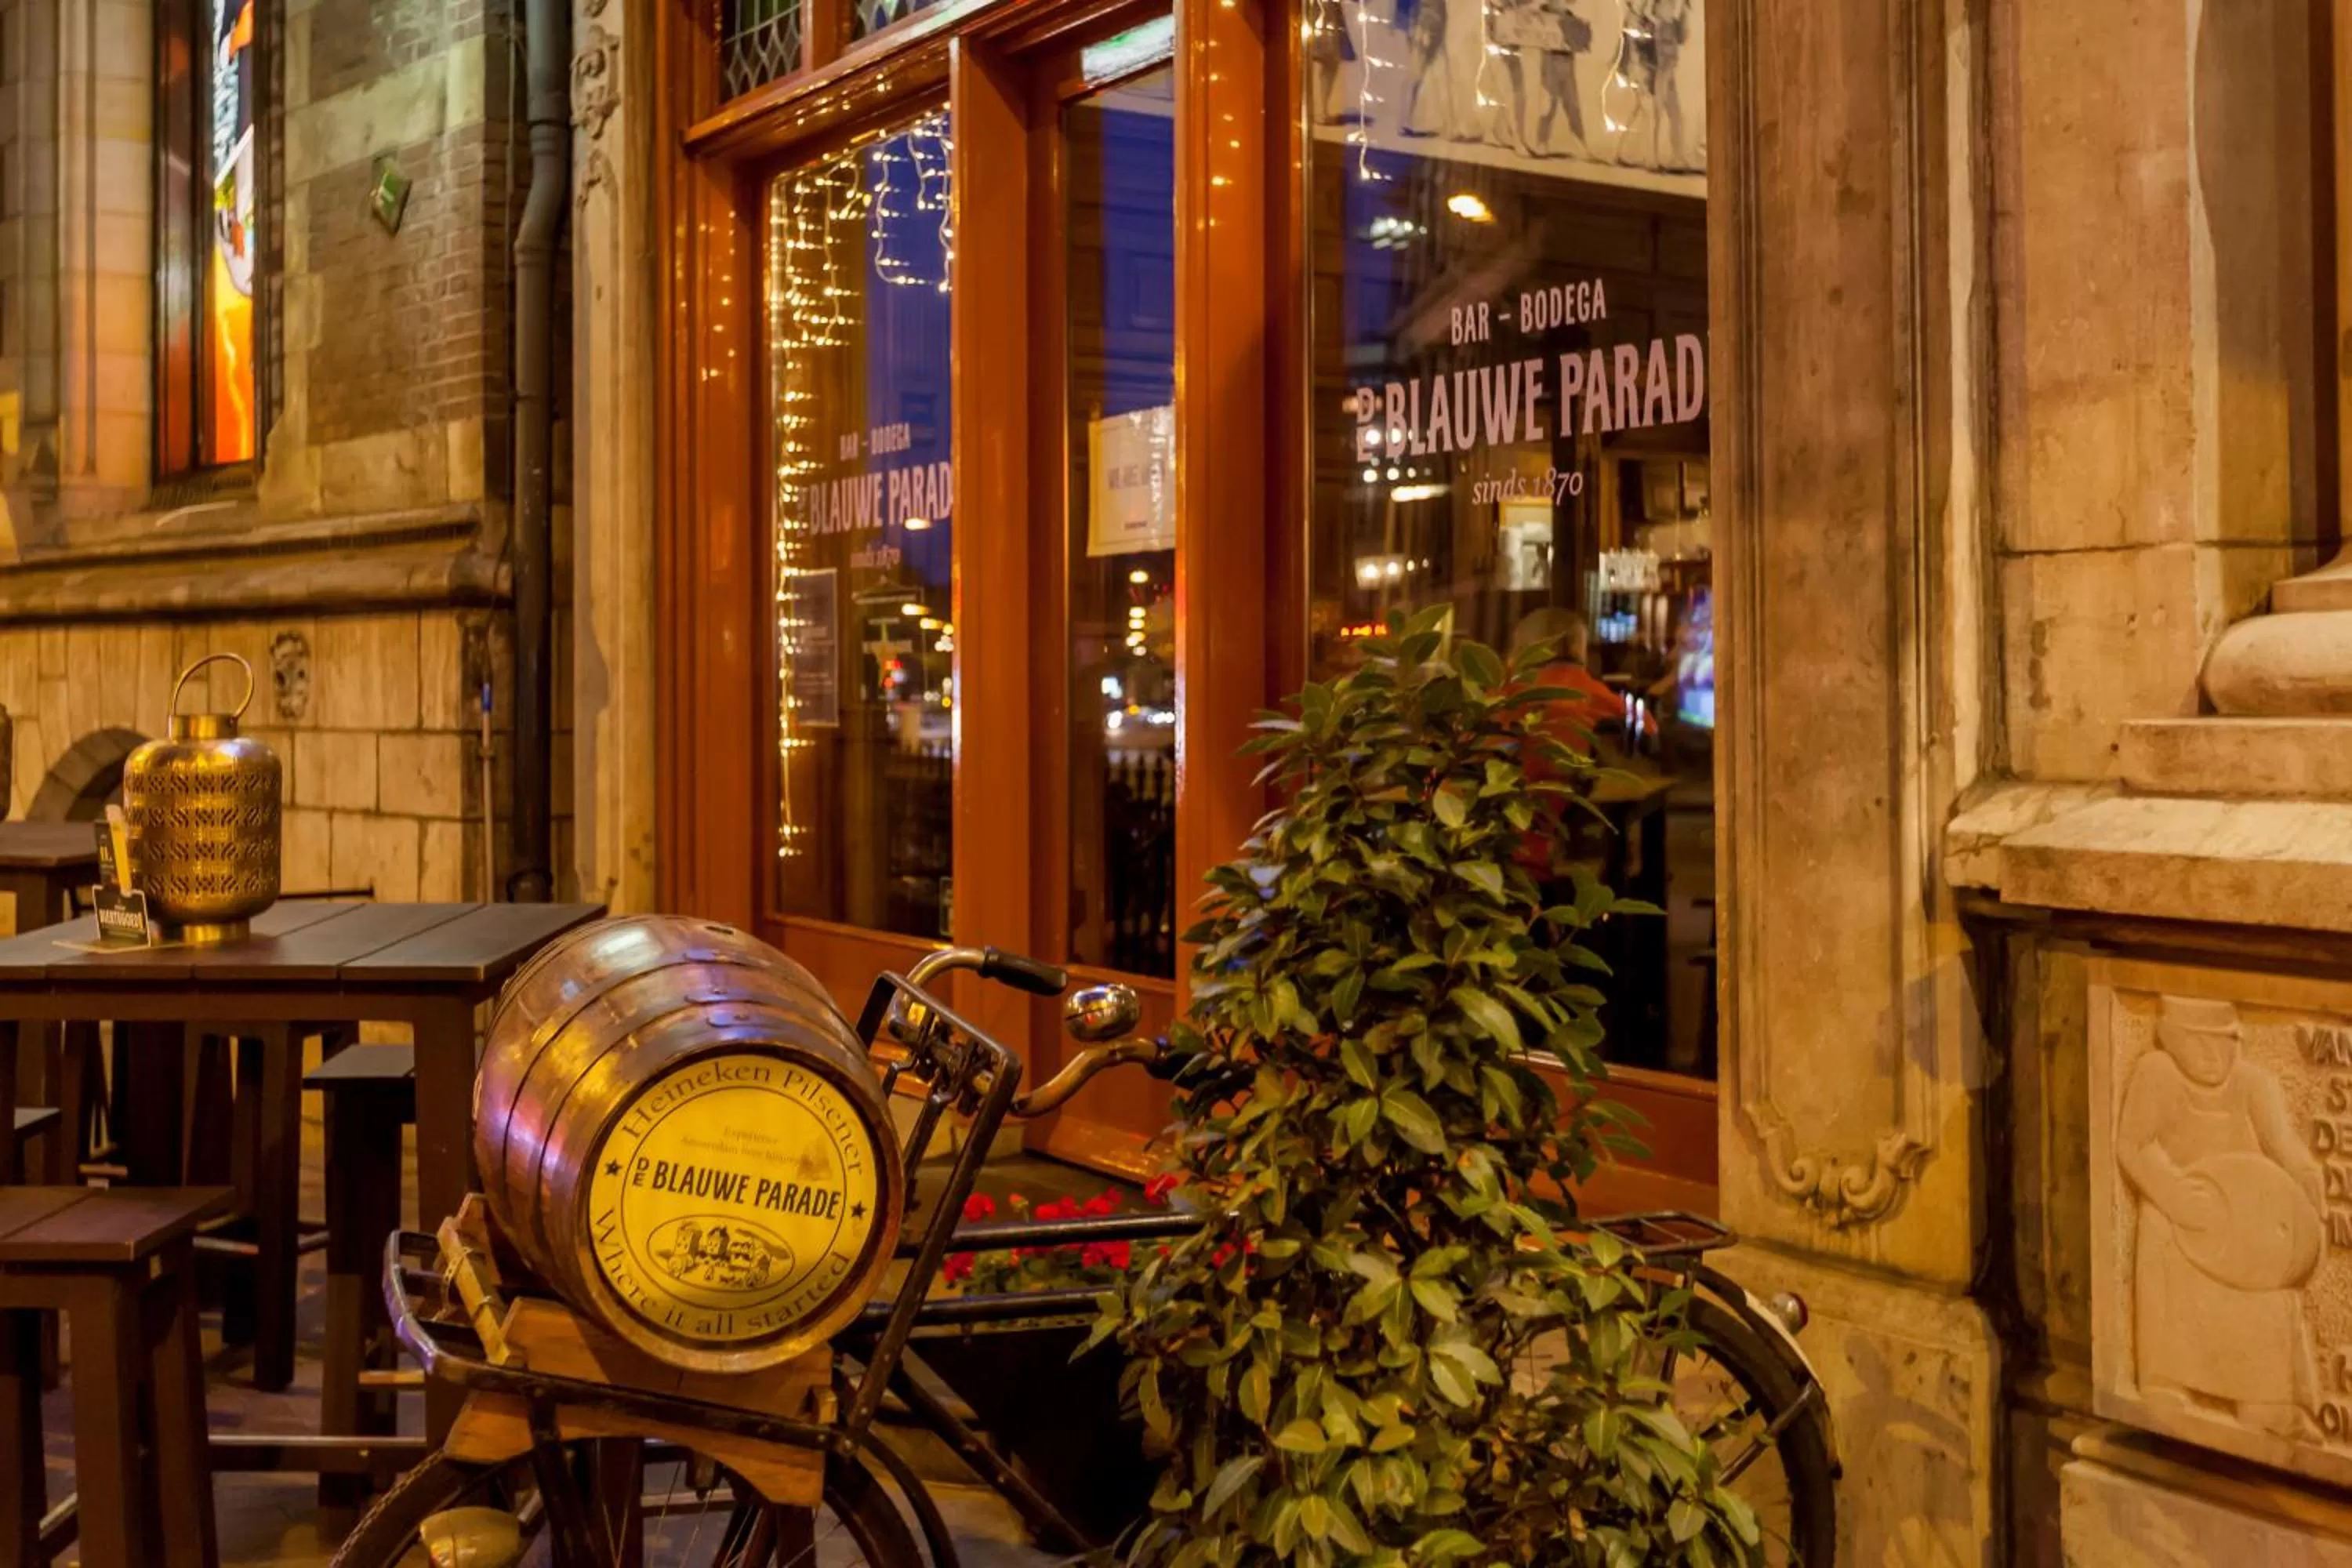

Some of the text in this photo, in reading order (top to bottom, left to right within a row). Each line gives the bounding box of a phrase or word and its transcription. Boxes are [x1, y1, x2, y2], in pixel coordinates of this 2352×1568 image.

[1451, 301, 1490, 346] BAR
[1520, 278, 1606, 334] BODEGA
[1385, 358, 1544, 459] BLAUWE
[810, 472, 884, 535] BLAUWE
[1472, 467, 1584, 506] sinds 1870
[622, 1061, 864, 1176] Heineken Pilsener
[652, 1160, 750, 1205] BLAUWE
[754, 1178, 842, 1221] PARADE
[596, 1208, 851, 1334] Where it all started
